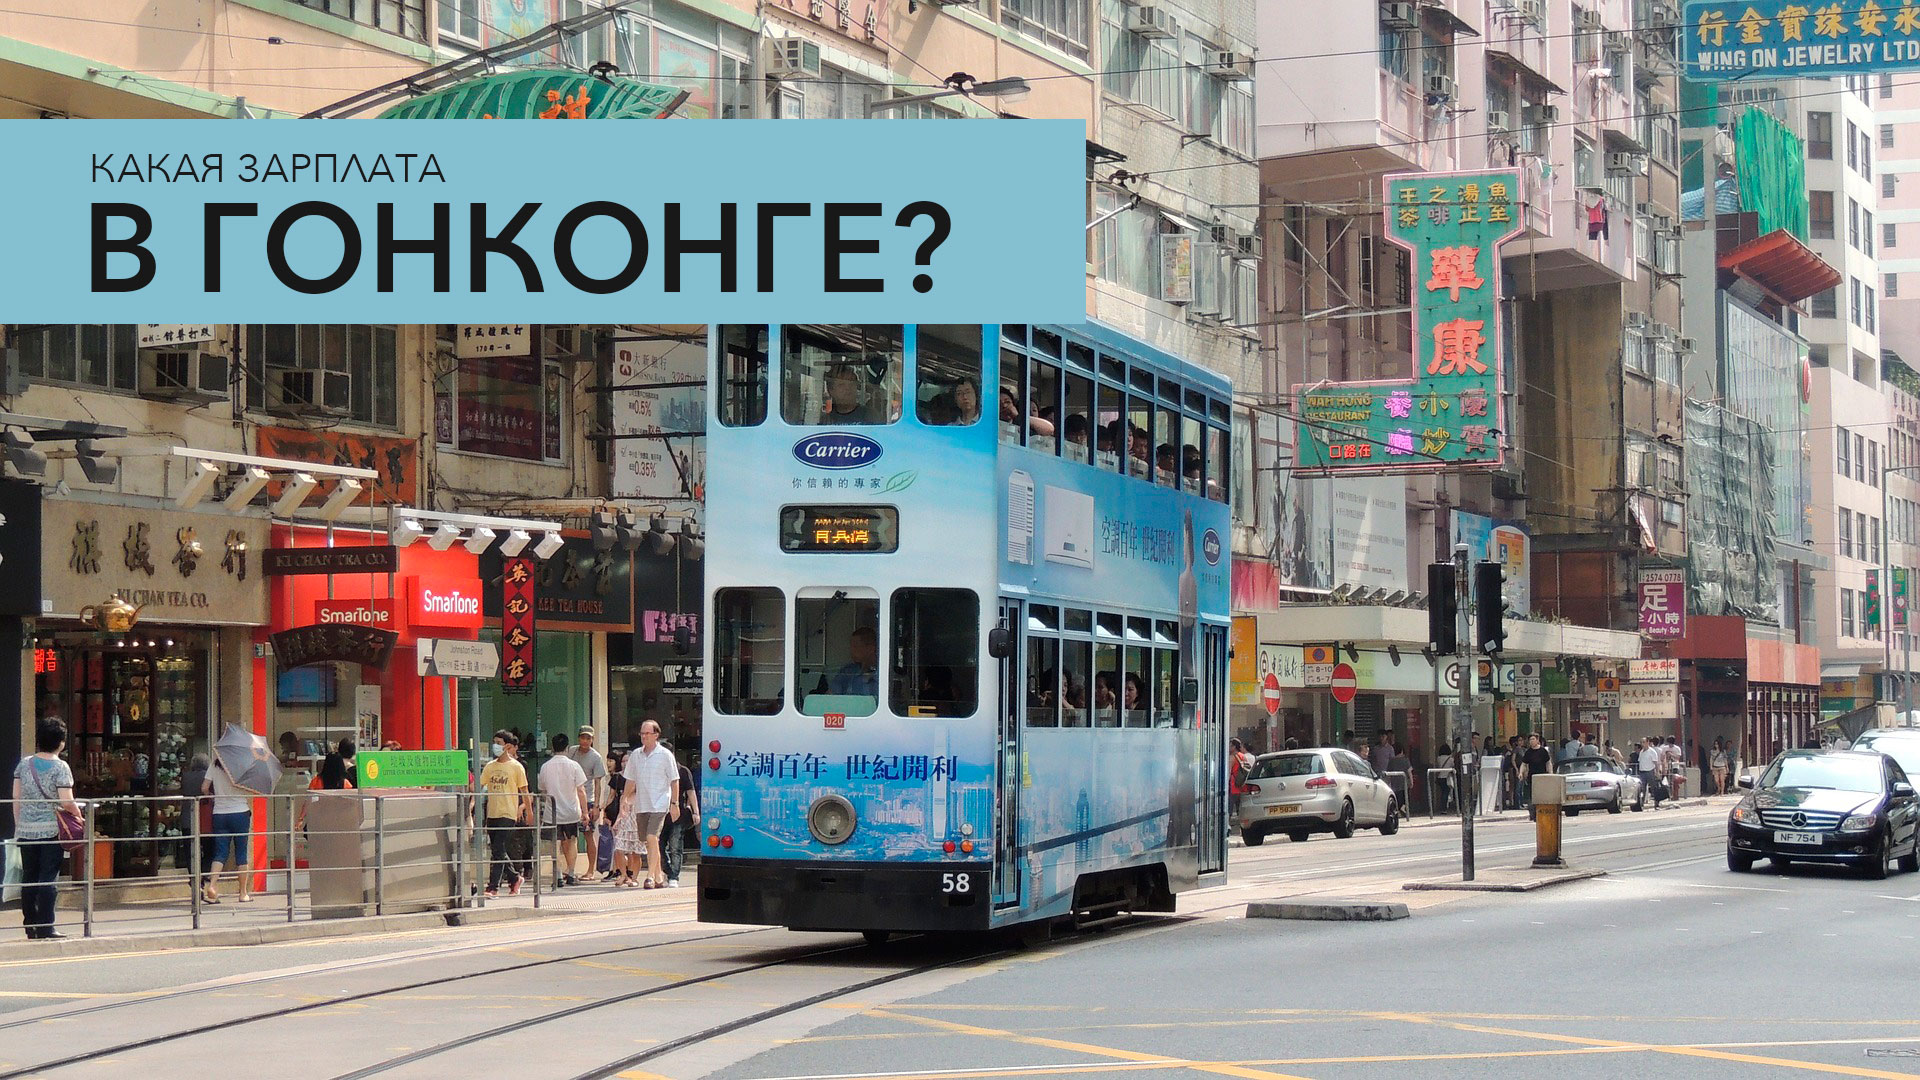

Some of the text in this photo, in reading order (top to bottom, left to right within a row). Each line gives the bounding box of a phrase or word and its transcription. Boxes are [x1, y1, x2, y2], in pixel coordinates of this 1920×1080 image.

[1698, 51, 1746, 71] WING
[1752, 49, 1777, 68] ON
[1783, 43, 1874, 67] JEWELRY
[1426, 245, 1488, 375] 華康
[1305, 410, 1372, 422] RESTAURANT
[805, 442, 871, 458] Carrier
[792, 477, 881, 489] 你信賴的專家
[1101, 515, 1138, 559] 空調百年
[276, 555, 292, 567] KI
[296, 554, 332, 566] CHAN
[1646, 573, 1663, 582] 2574
[1665, 573, 1681, 582] 0778
[133, 590, 165, 607] CHAN
[167, 591, 189, 607] TEA
[191, 593, 209, 608] CO.
[424, 589, 478, 614] SmarTone
[1641, 584, 1668, 611] 足
[321, 607, 389, 623] SmarTone
[559, 599, 573, 613] TEA
[577, 600, 603, 615] HOUSE
[471, 645, 483, 655] Road
[826, 717, 843, 726] 020
[727, 751, 958, 782] 空調百年 世紀開利
[1781, 833, 1815, 842] NF 754
[942, 873, 970, 893] 58
